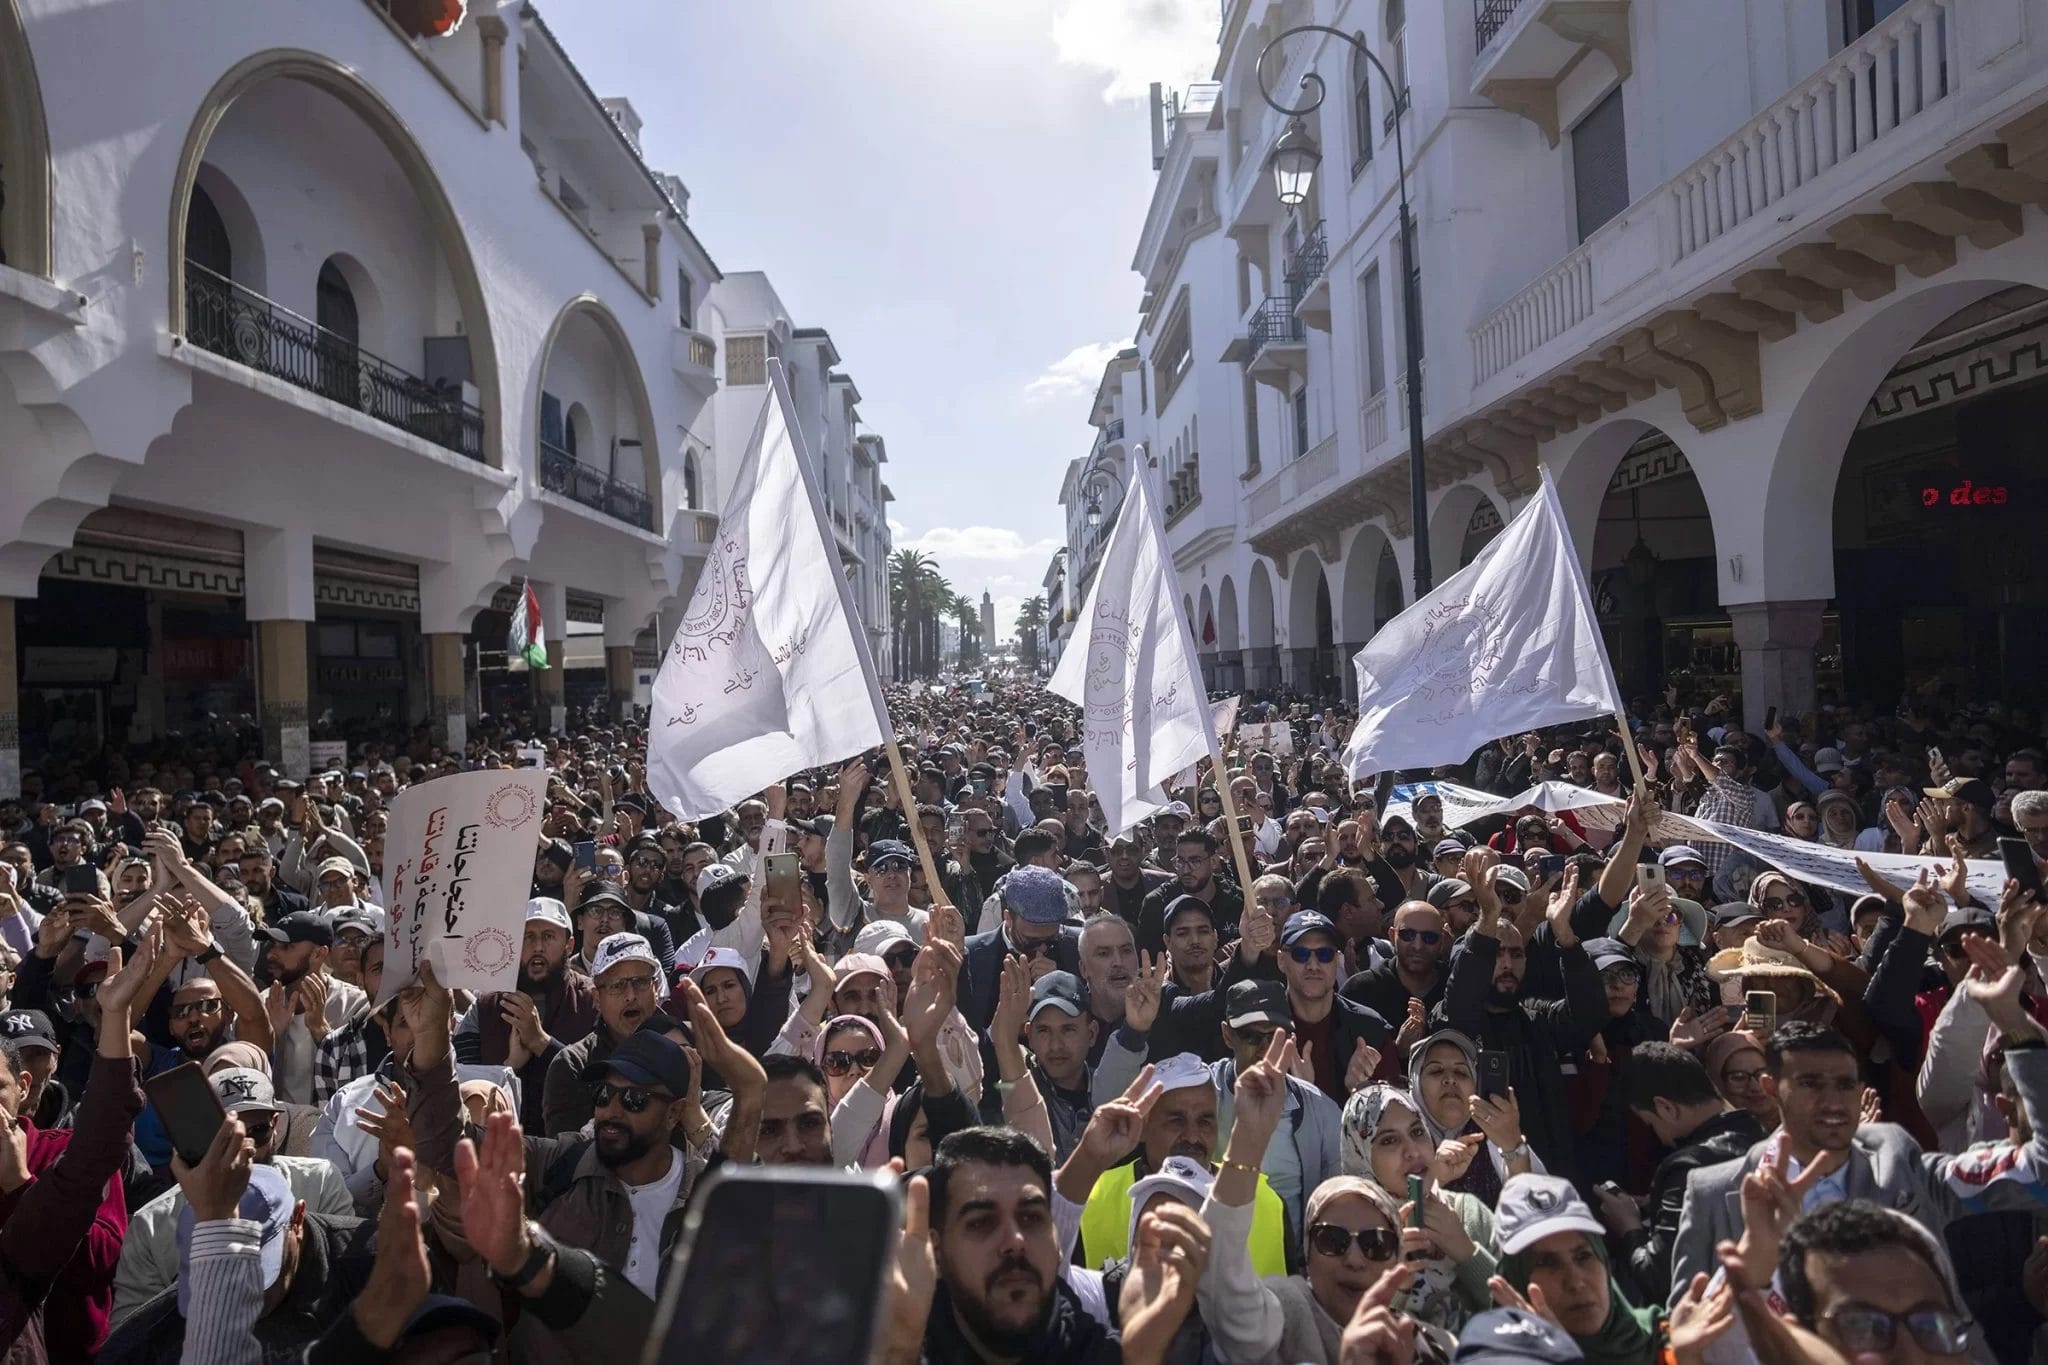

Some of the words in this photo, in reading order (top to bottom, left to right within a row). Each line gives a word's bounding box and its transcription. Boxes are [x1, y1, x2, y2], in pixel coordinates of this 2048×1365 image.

[1949, 479, 2008, 506] des
[390, 858, 412, 949] مرفوعة
[443, 824, 480, 939] احتجاجاتنا
[409, 883, 437, 976] مشروعة
[218, 1075, 259, 1100] NY
